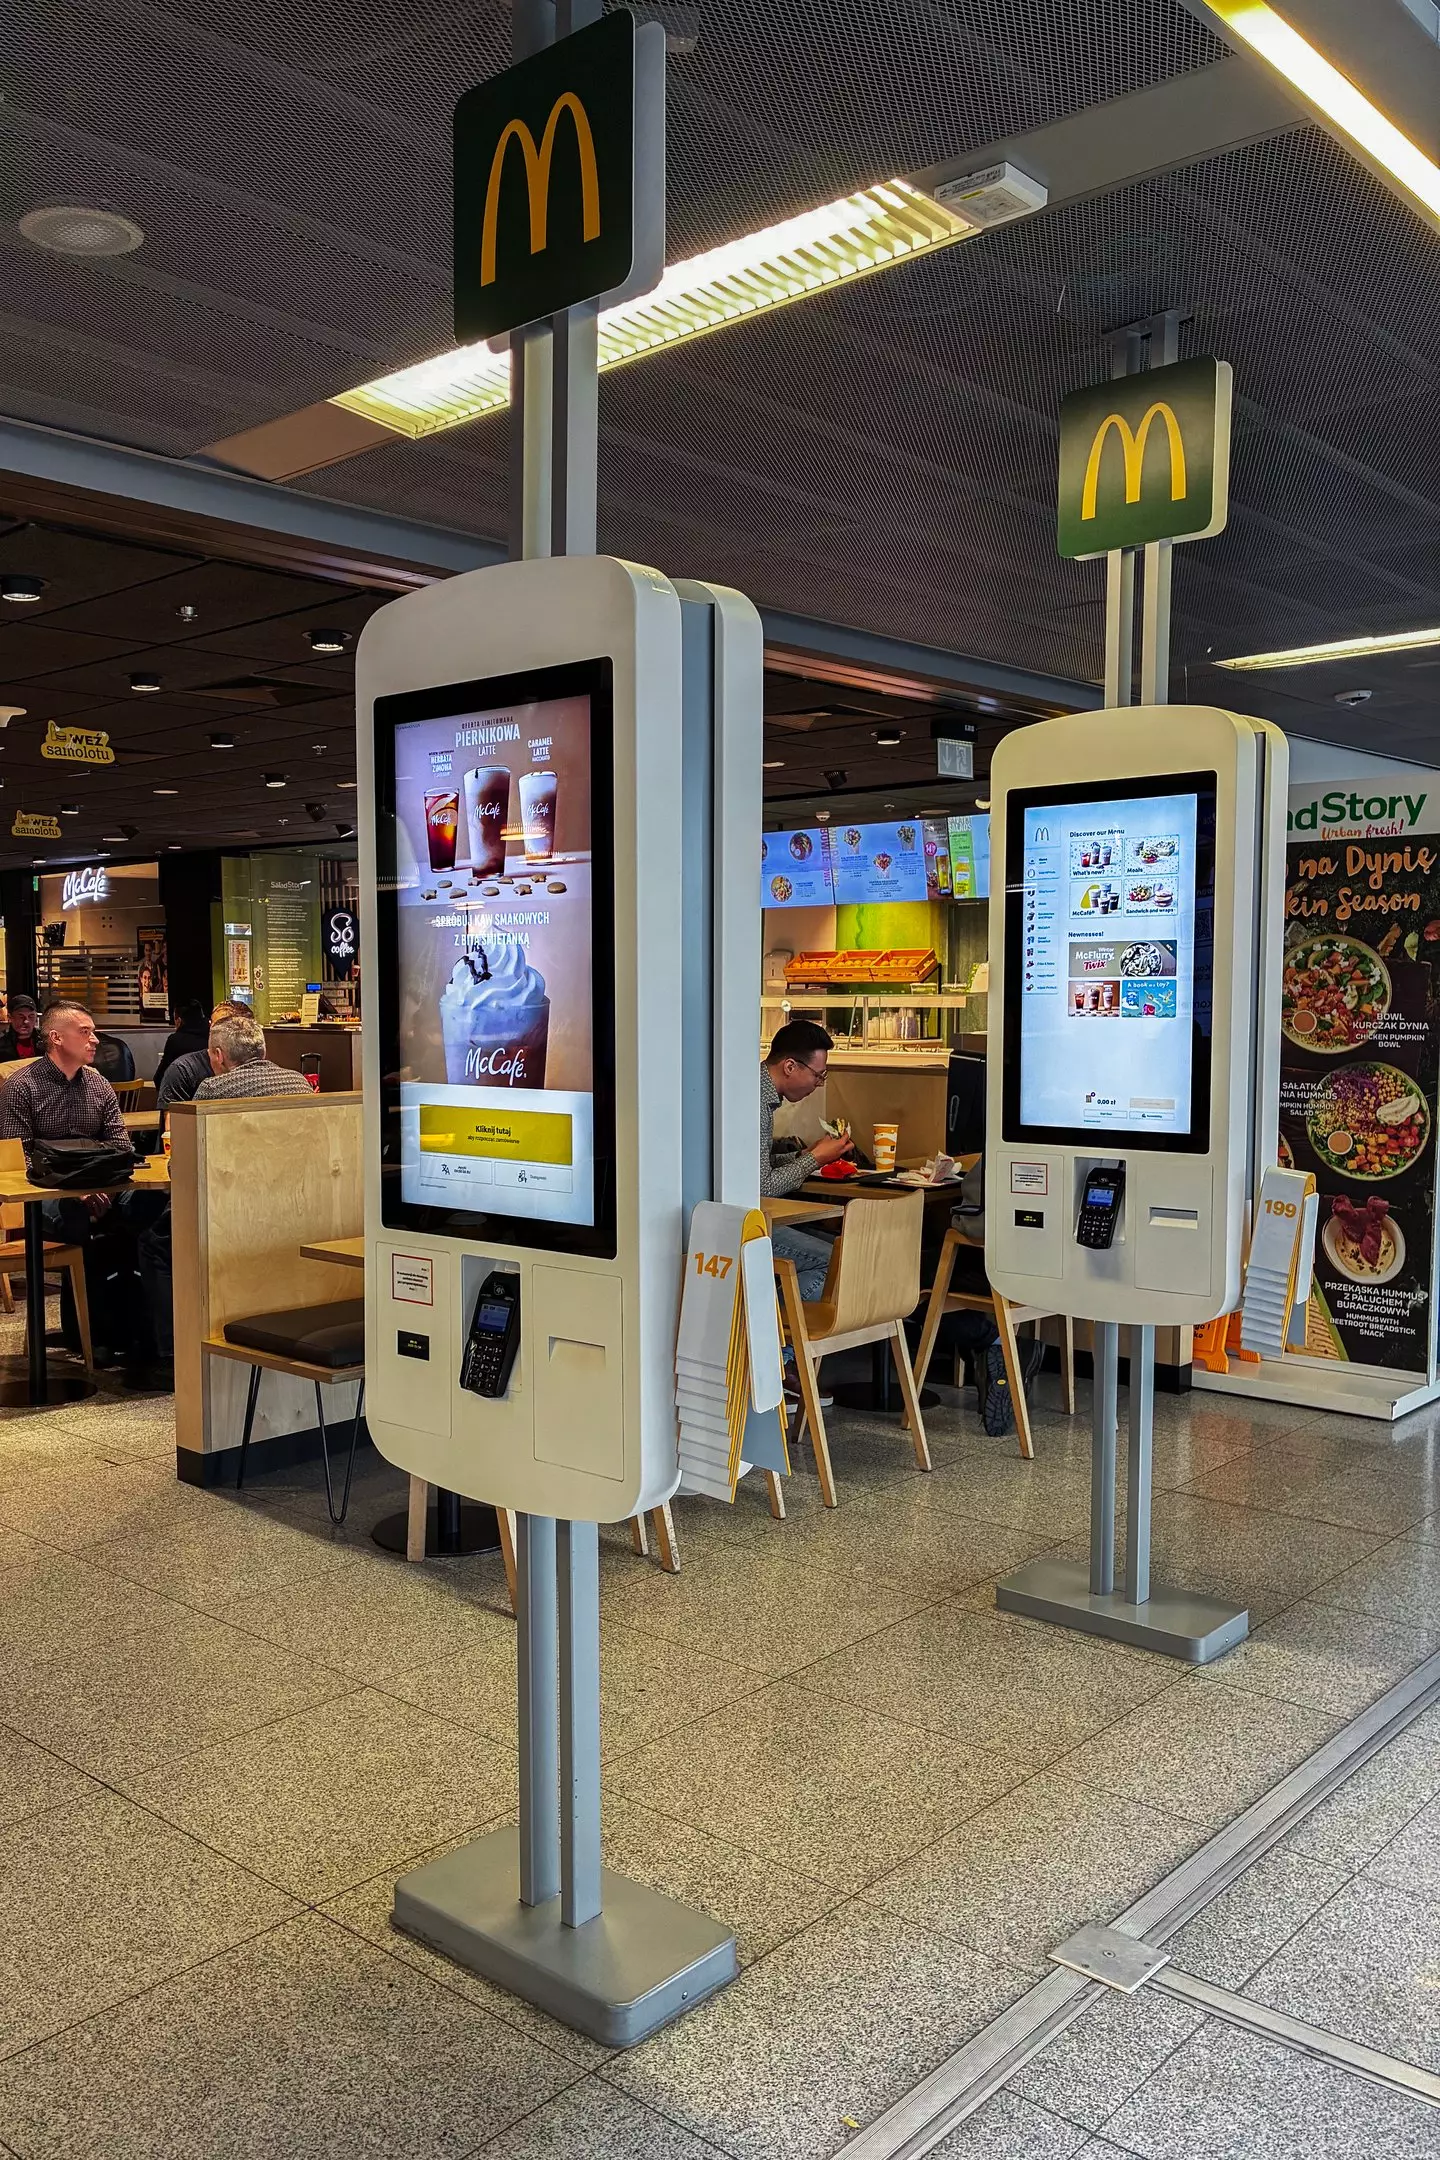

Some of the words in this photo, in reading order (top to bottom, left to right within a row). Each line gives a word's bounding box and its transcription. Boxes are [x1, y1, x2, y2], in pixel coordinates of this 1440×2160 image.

[72, 734, 104, 746] WEŹ
[456, 724, 520, 747] PIERNIKOWA
[528, 737, 553, 748] CARAMEL
[46, 745, 110, 760] samolotu
[479, 745, 496, 756] LATTE
[533, 747, 549, 756] LATTE
[15, 826, 58, 836] samolotu
[1322, 826, 1362, 840] Urban
[1365, 819, 1404, 838] fresh!
[1299, 856, 1339, 880] na
[1346, 845, 1438, 890] Dynię
[63, 867, 107, 910] McCafé
[1335, 886, 1421, 921] Season
[495, 911, 550, 926] SMAKOWYCH
[454, 934, 460, 946] Z
[331, 941, 355, 958] coffee
[1083, 960, 1106, 971] Twix
[1352, 1021, 1398, 1030] KURCZAK
[1399, 1022, 1430, 1030] DYNIA
[1282, 1082, 1323, 1091] SAŁATKA
[1297, 1091, 1338, 1100] HUMMUS
[475, 1125, 496, 1136] Kliknij
[496, 1127, 511, 1137] tutaj
[1264, 1199, 1297, 1218] 199
[694, 1252, 733, 1279] 147
[1324, 1282, 1380, 1296] PRZEKĄSKA
[1381, 1289, 1424, 1302] HUMMUS
[1344, 1293, 1350, 1301] Z
[1351, 1294, 1403, 1308] PALUCHEM
[1336, 1301, 1410, 1317] BURACZKOWYM
[1329, 1318, 1367, 1329] BEETROOT
[1369, 1322, 1416, 1336] BREADSTICK
[1346, 1313, 1379, 1323] HUMMUS
[1380, 1317, 1400, 1326] WITH
[1359, 1329, 1385, 1339] SNACK
